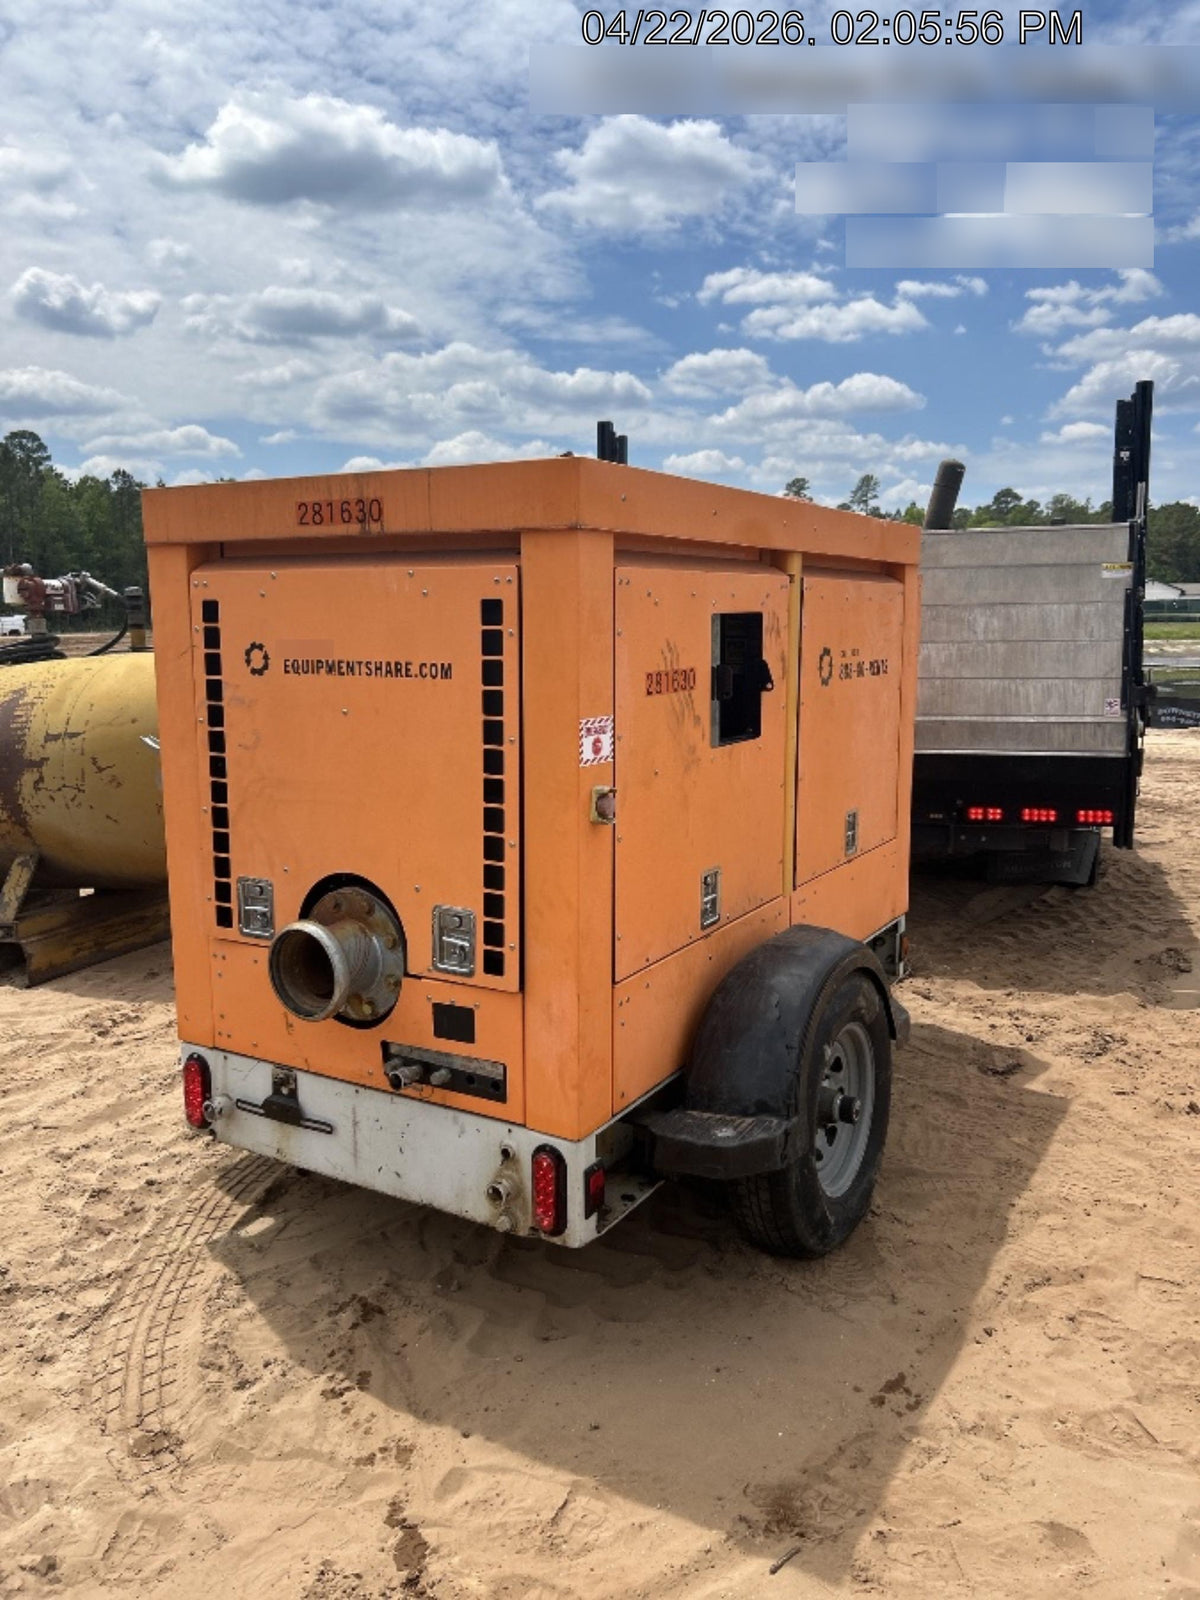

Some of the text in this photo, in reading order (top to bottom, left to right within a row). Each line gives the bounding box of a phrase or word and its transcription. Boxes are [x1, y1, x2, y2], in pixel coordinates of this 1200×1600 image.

[298, 499, 382, 525] 281630
[283, 658, 452, 680] EQUIPMENTSHARE.COM
[646, 667, 696, 696] 281630
